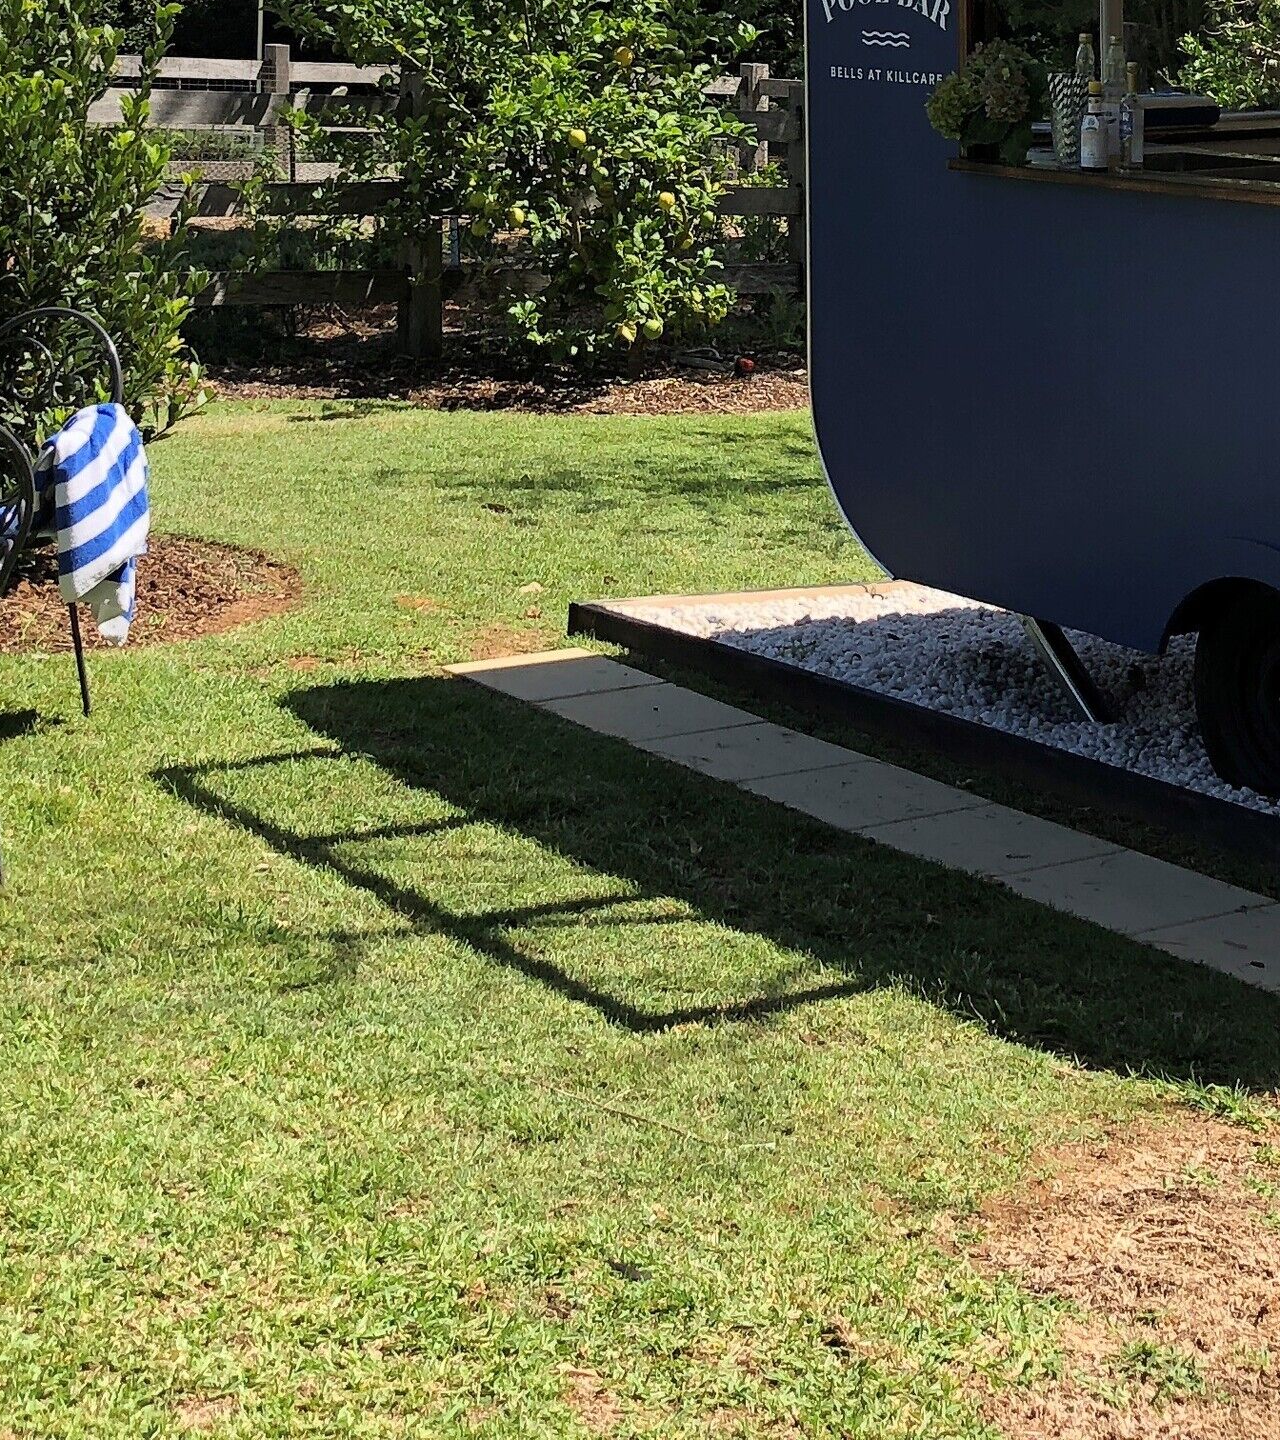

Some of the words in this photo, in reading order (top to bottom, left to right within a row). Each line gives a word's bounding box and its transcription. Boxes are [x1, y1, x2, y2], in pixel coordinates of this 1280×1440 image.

[830, 66, 863, 80] BELLS
[868, 69, 882, 81] AT
[886, 70, 943, 85] KILLCARE
